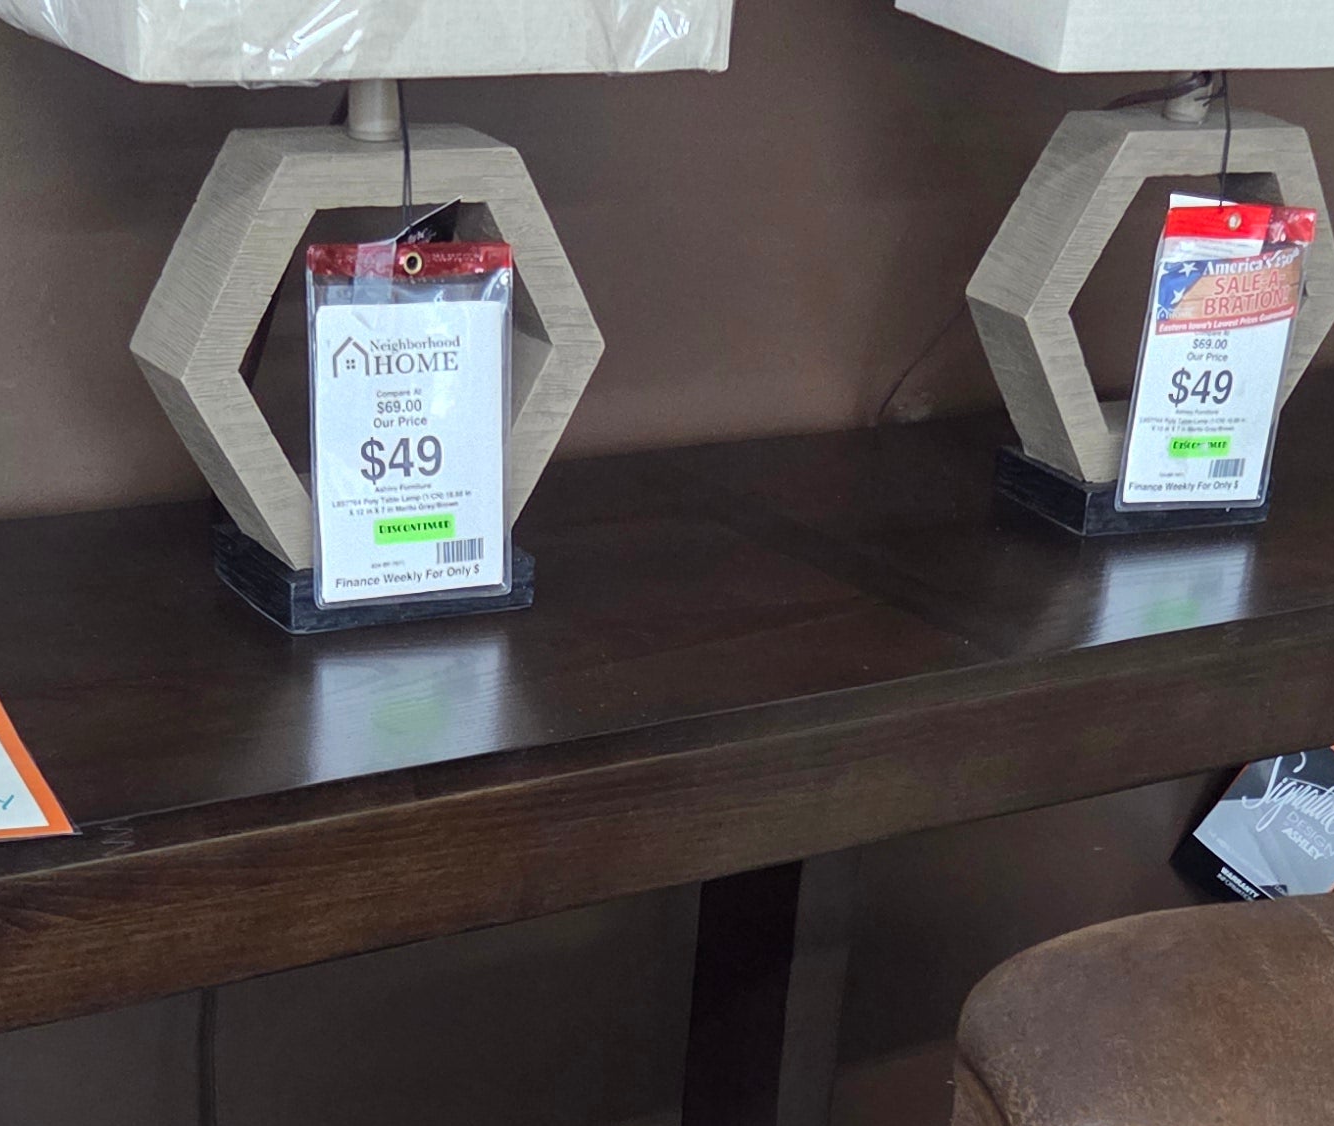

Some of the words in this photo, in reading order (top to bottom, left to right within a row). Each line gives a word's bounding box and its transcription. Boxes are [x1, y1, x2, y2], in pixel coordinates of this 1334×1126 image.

[370, 335, 461, 354] Neighborhood
[1192, 339, 1228, 350] $69.00
[374, 351, 459, 375] HOME
[1187, 352, 1204, 361] Our
[1206, 352, 1228, 361] Price
[376, 389, 411, 398] Compare
[1168, 367, 1233, 408] $49
[376, 400, 422, 414] $69.00
[373, 417, 395, 428] Our
[398, 416, 427, 427] Price
[360, 435, 443, 485] $49
[1128, 482, 1163, 491] Finance
[1165, 482, 1196, 492] Weekly
[1196, 482, 1211, 490] For
[1213, 481, 1232, 490] Only
[1233, 480, 1239, 490] $
[379, 520, 451, 534] DISCONTINUED
[335, 577, 380, 588] Finance
[383, 571, 423, 583] Weekly
[425, 569, 443, 579] For
[447, 566, 471, 577] Only
[473, 564, 480, 574] $
[1281, 827, 1325, 861] ASHLEY
